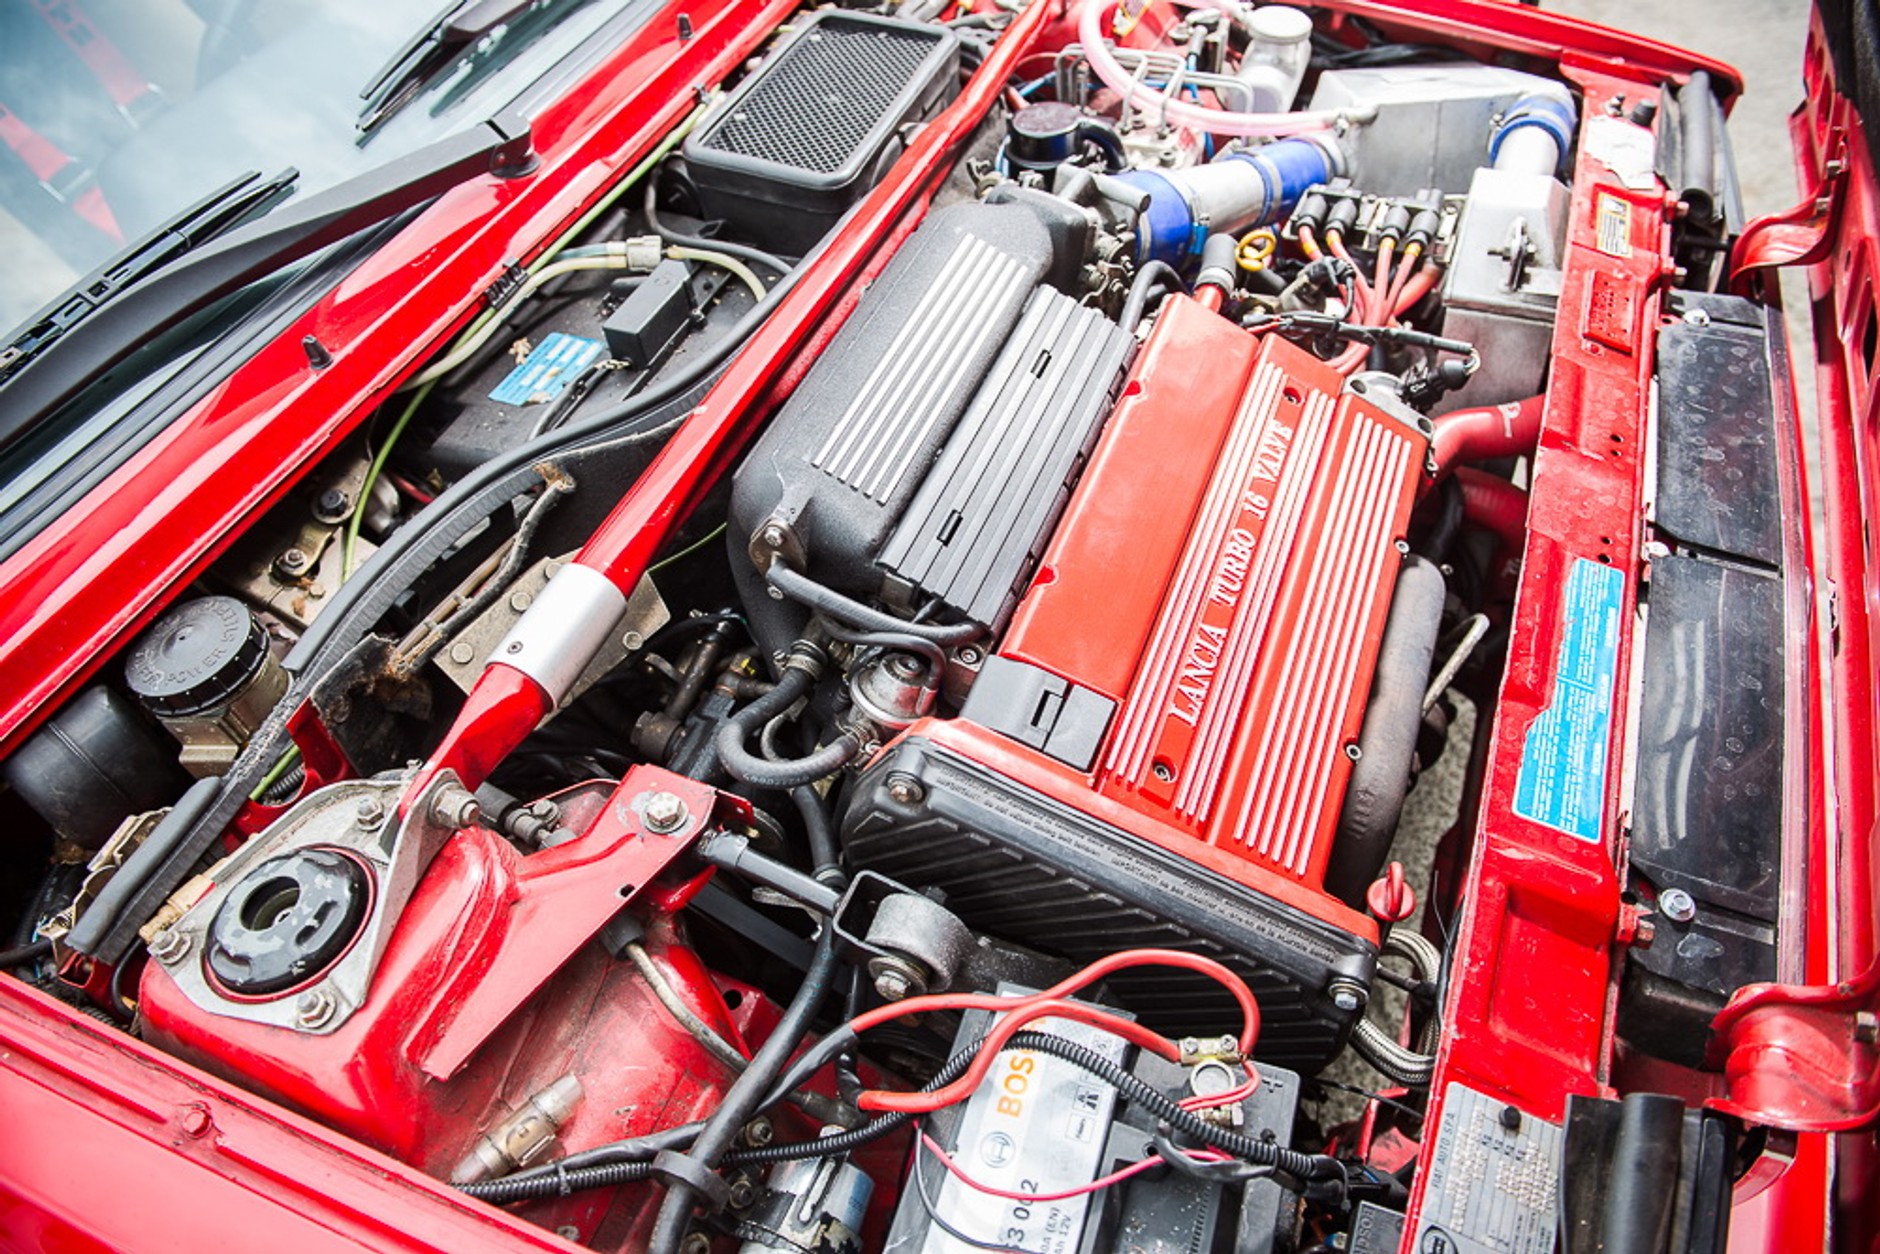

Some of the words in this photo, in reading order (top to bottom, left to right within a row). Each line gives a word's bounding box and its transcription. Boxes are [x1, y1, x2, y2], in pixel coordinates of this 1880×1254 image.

[1253, 419, 1293, 485] VALVE
[1243, 489, 1269, 521] 16
[1210, 528, 1256, 607] TURBO
[1168, 622, 1227, 727] LANCIA
[996, 1019, 1046, 1117] BOS
[1432, 1168, 1442, 1189] FIAT
[1437, 1137, 1450, 1163] AUTO
[1059, 1216, 1071, 1236] 12V
